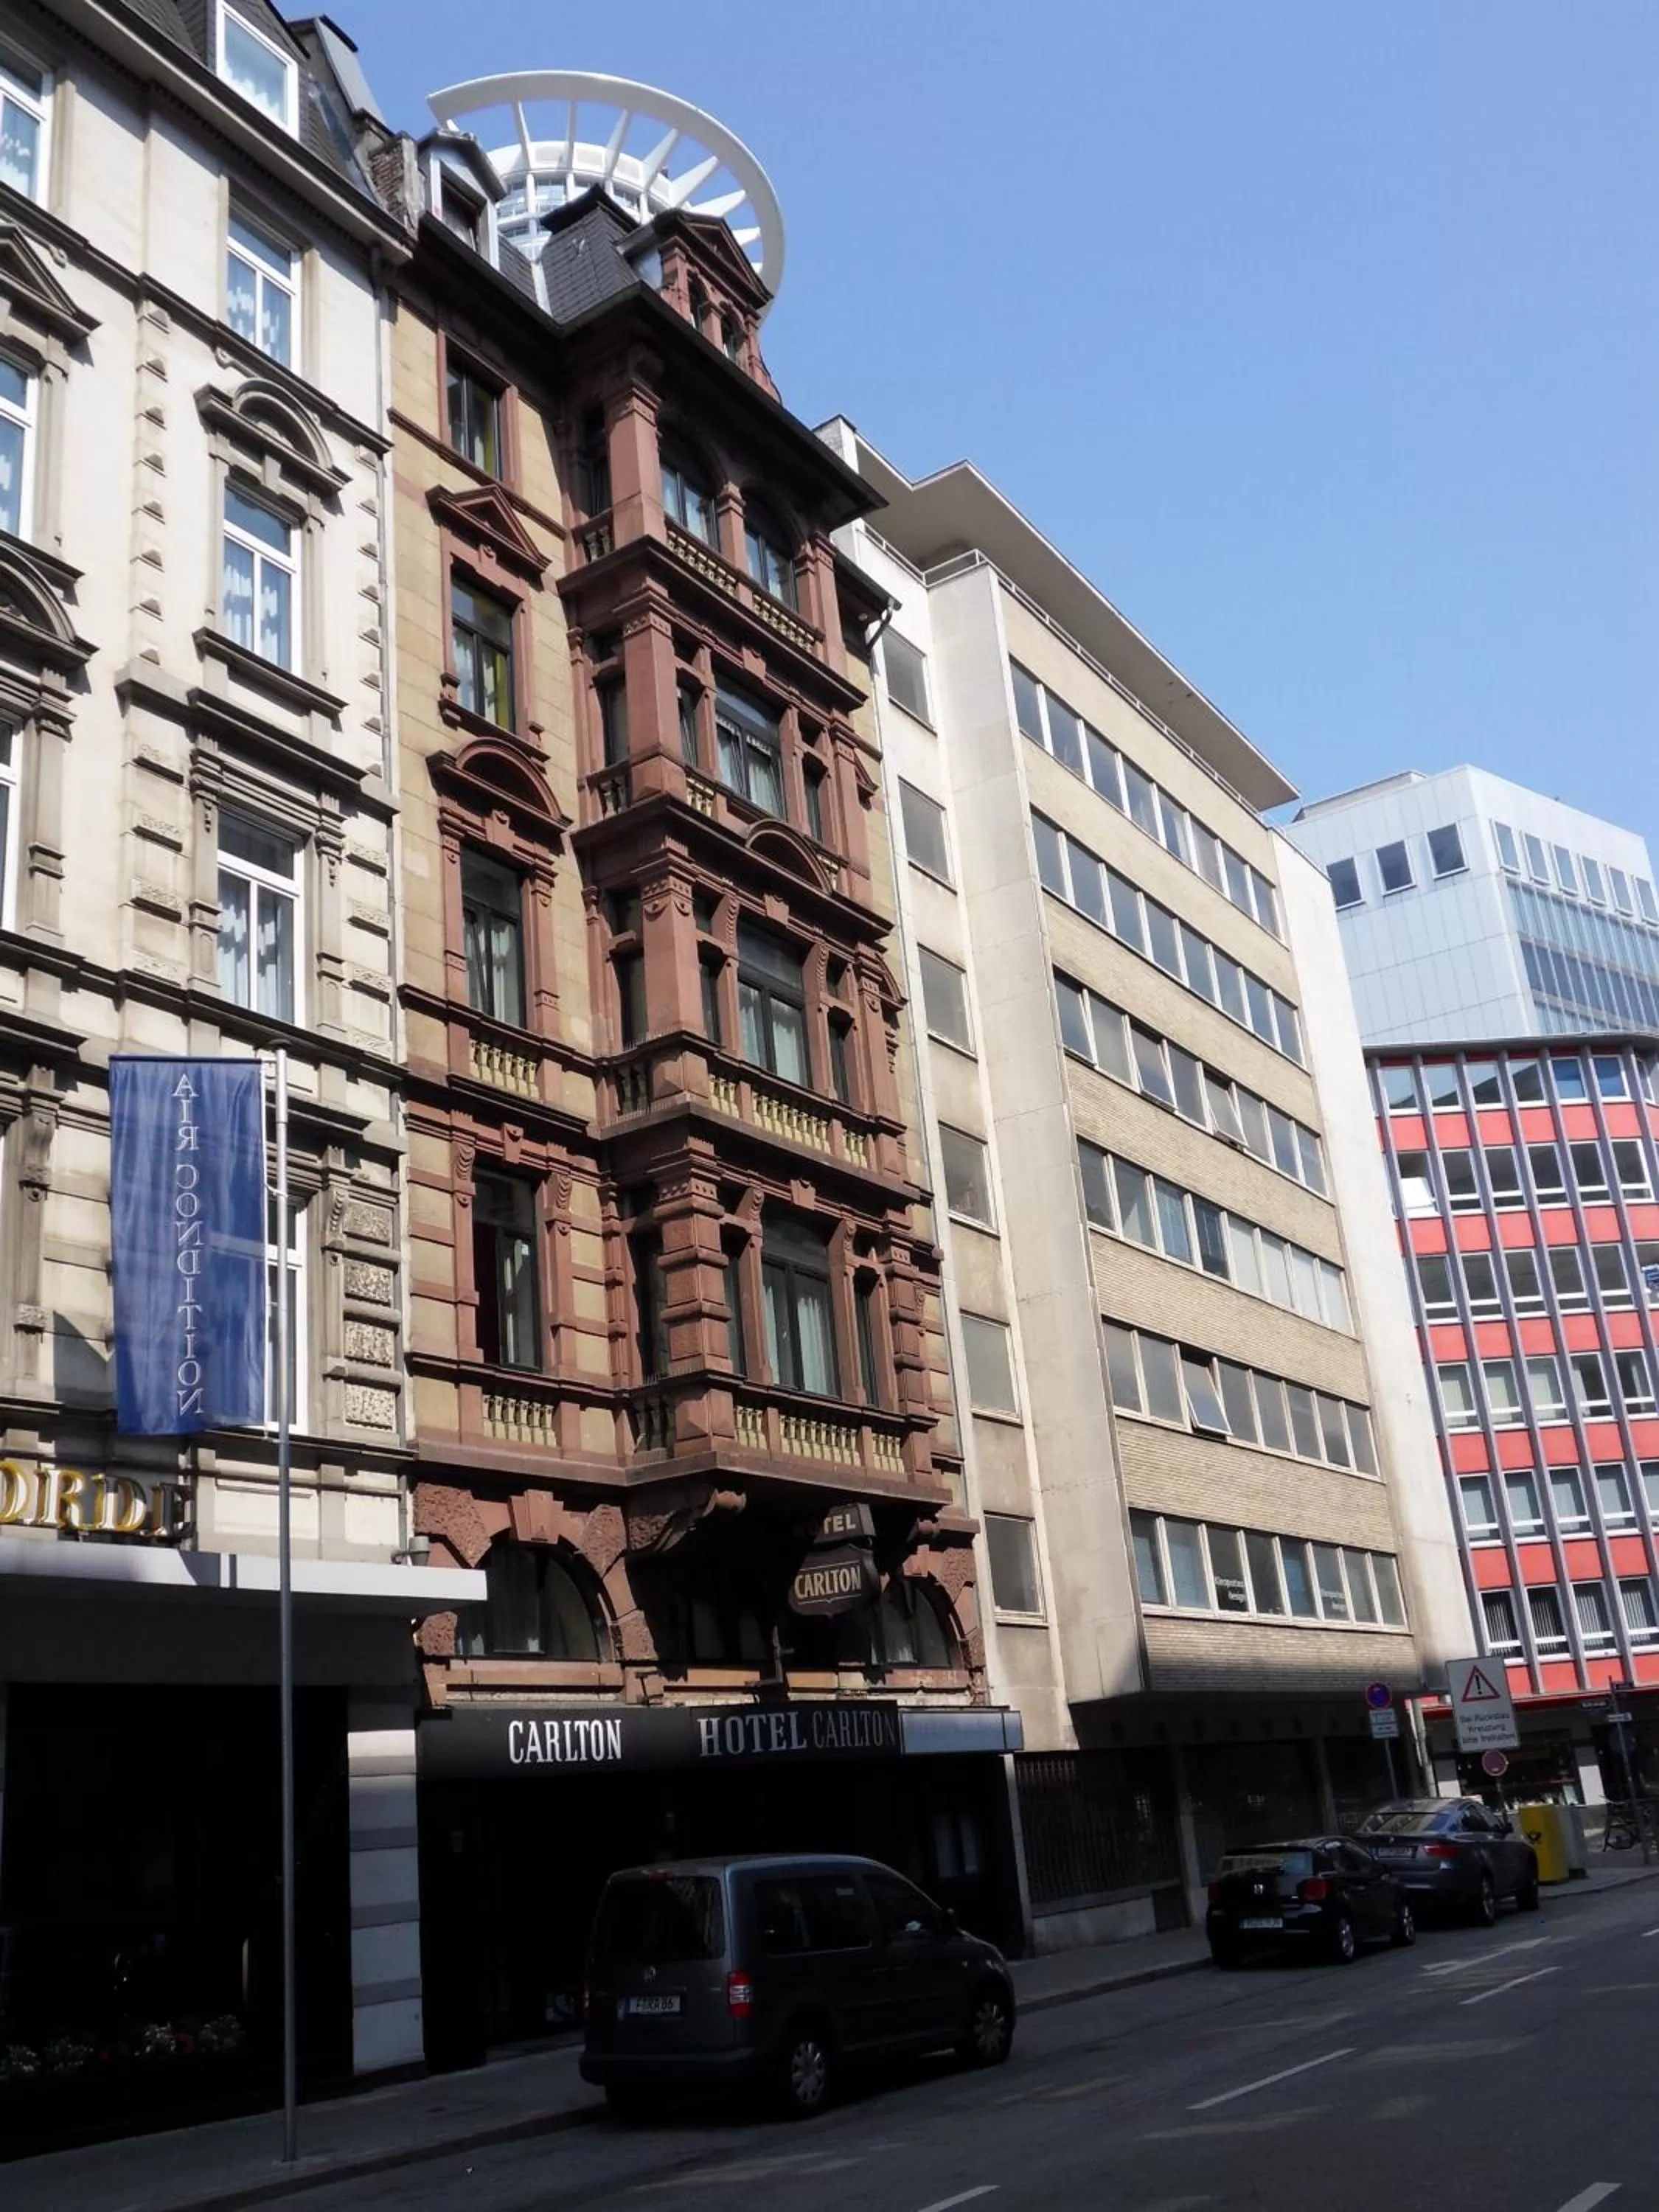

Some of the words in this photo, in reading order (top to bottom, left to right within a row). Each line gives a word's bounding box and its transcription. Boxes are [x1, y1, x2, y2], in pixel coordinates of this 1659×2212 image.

[793, 1565, 862, 1599] CARLTON
[508, 1719, 622, 1764] CARLTON
[697, 1711, 807, 1757] HOTEL
[813, 1708, 897, 1750] CARLTON
